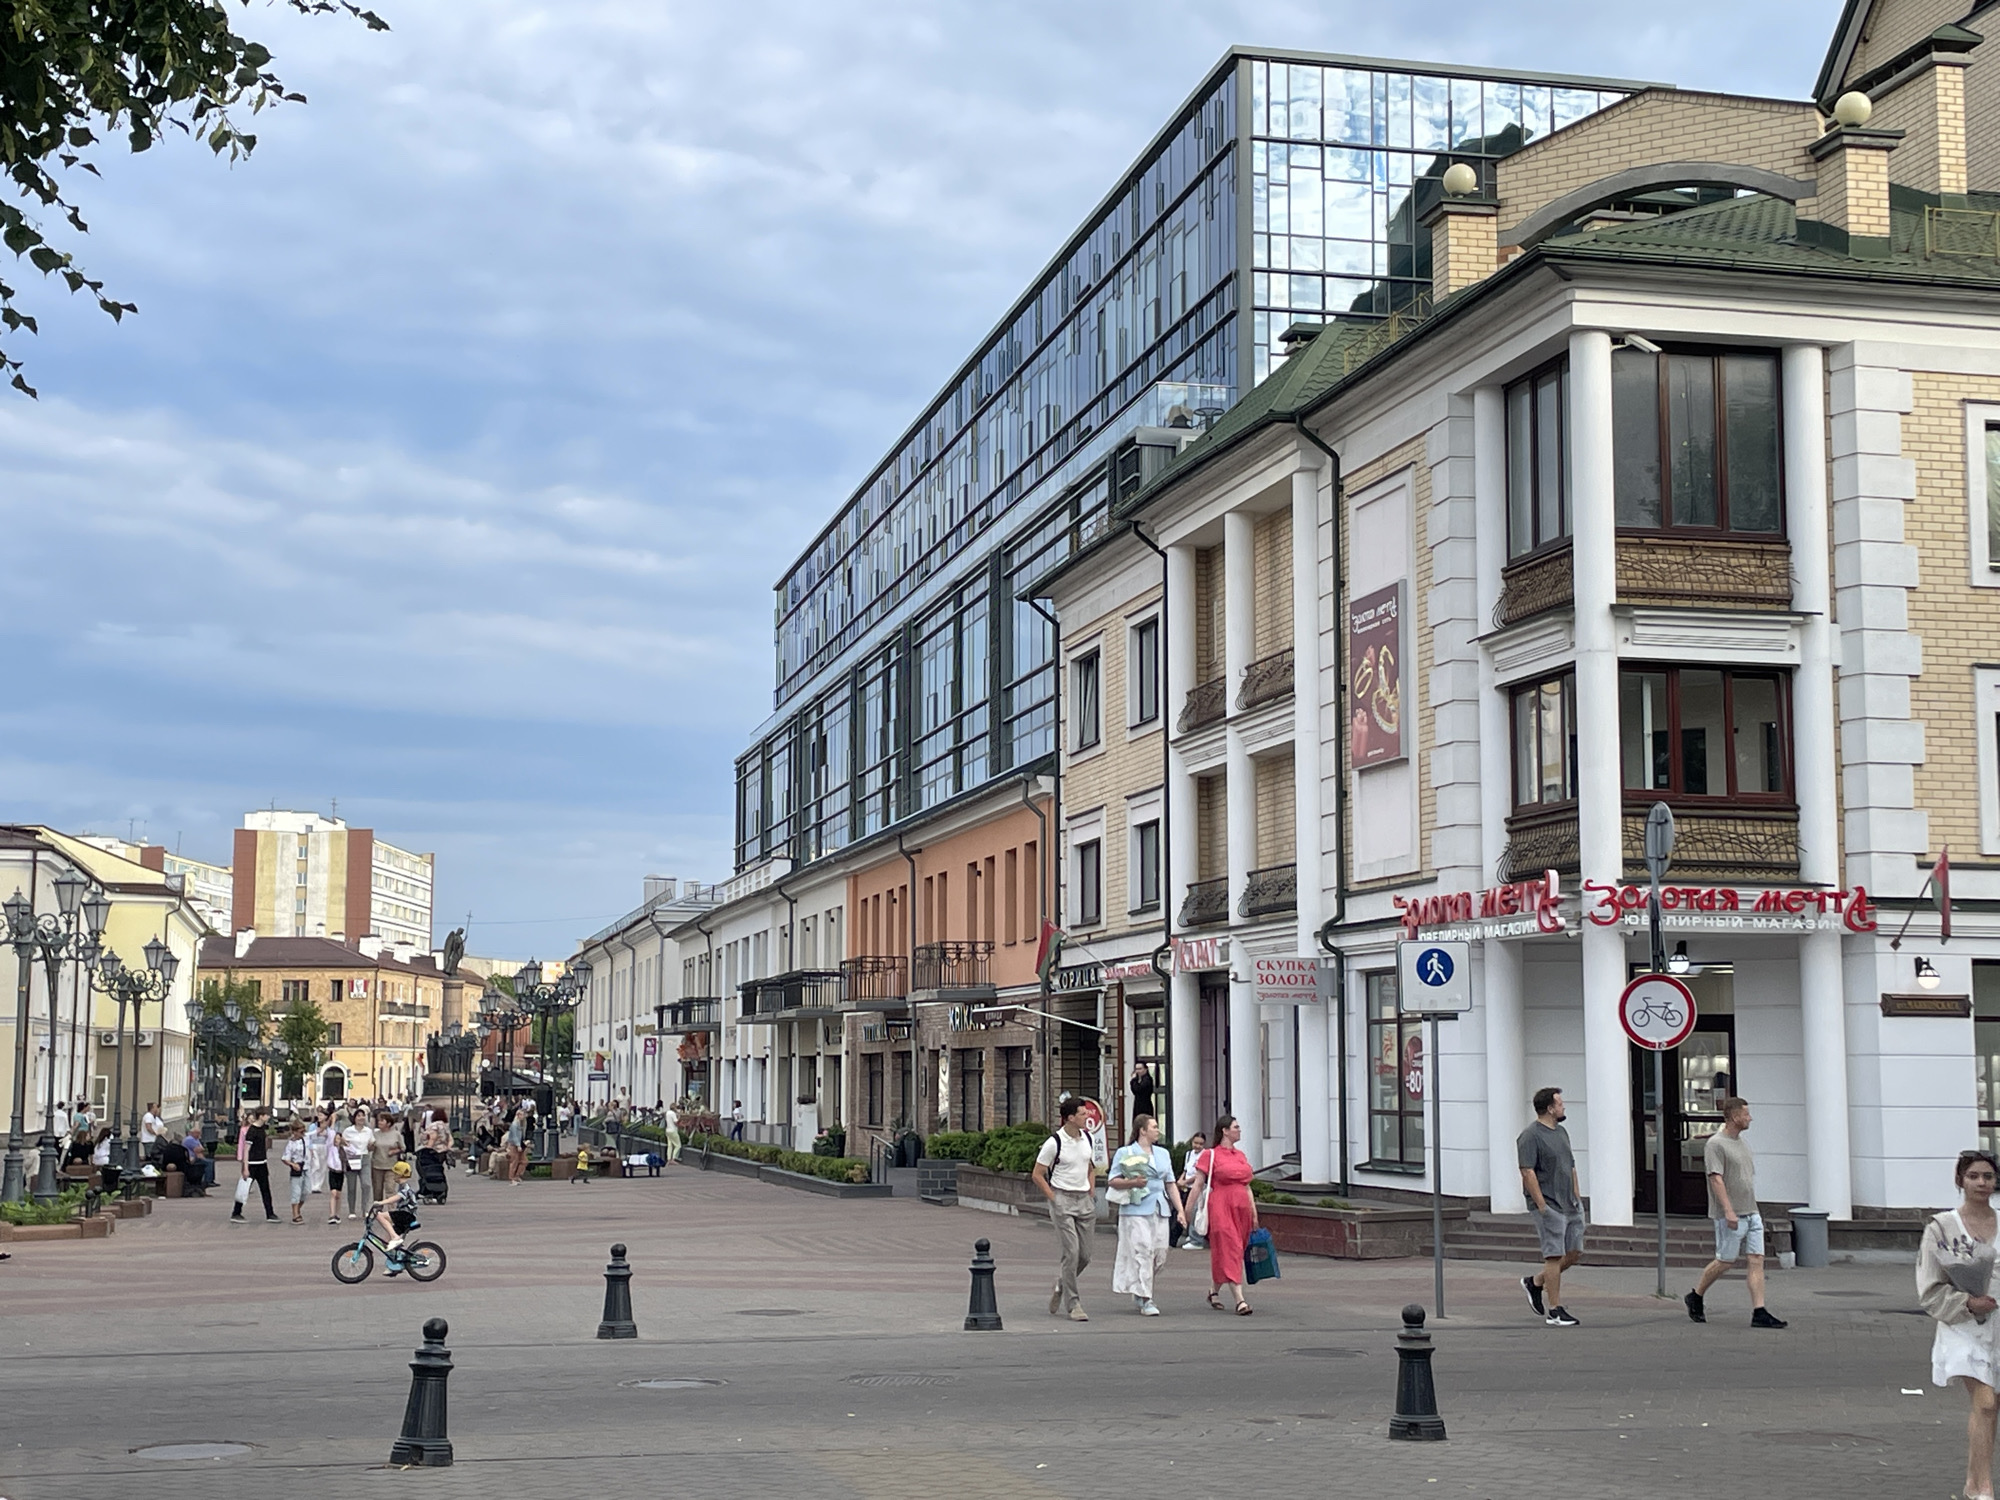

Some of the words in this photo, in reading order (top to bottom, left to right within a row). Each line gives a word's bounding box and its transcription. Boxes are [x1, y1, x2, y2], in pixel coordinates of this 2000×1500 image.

[1484, 919, 1539, 938] МАГАЗИН
[1624, 914, 1743, 928] ЮВЛИРНЫЙ
[1752, 918, 1841, 930] МАГАЗИН
[1256, 960, 1317, 971] СКУПКА
[1256, 973, 1317, 986] ЗОЛОТА
